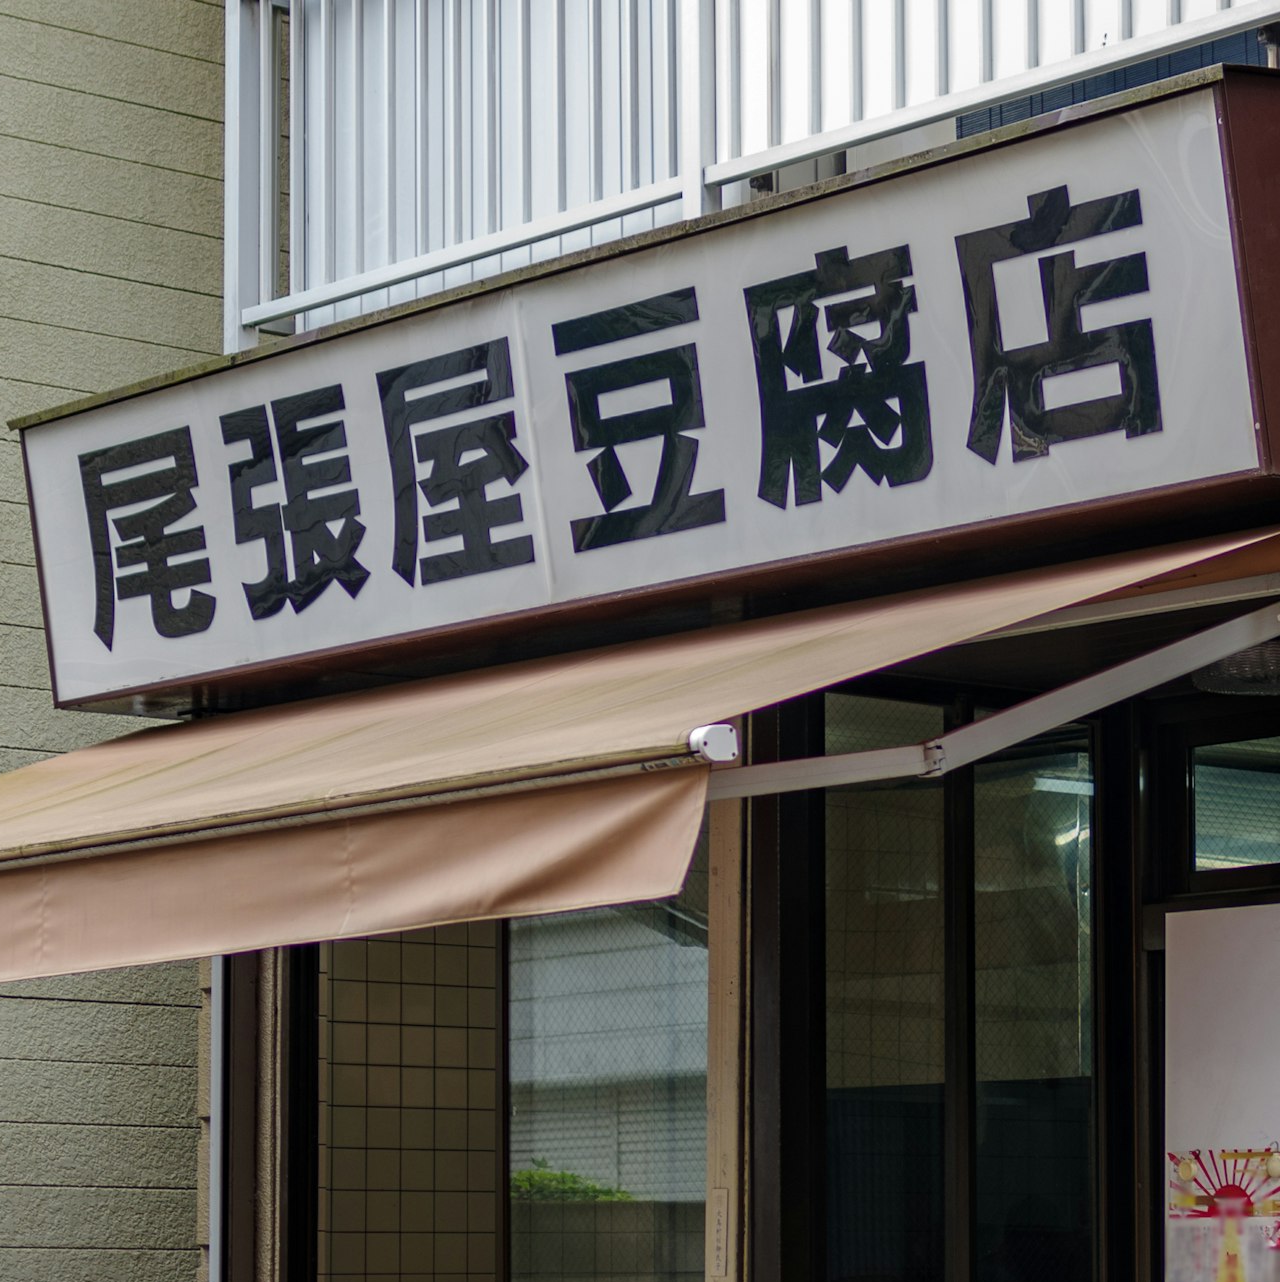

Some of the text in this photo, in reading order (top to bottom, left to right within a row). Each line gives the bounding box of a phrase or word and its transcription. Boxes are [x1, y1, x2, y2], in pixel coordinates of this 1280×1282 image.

[77, 184, 1163, 652] 尾張屋豆腐店
